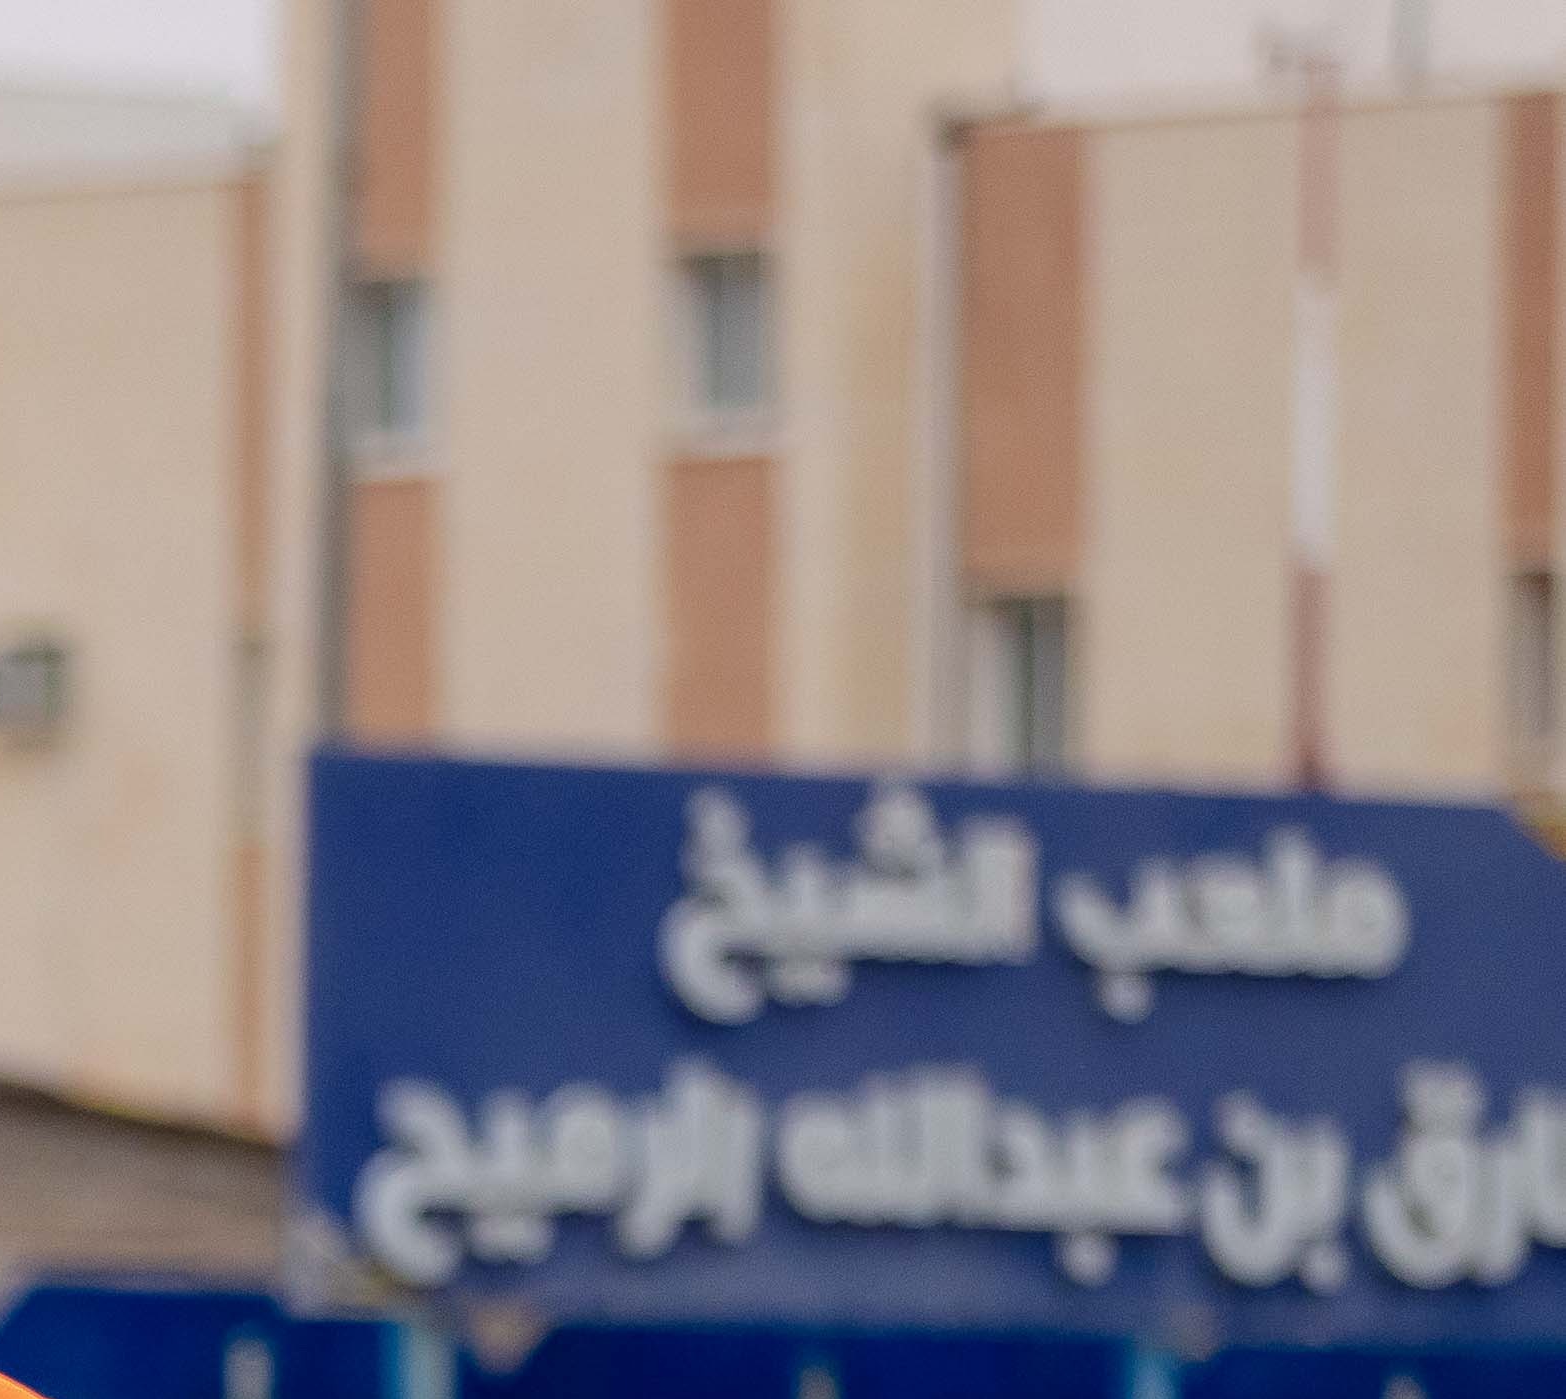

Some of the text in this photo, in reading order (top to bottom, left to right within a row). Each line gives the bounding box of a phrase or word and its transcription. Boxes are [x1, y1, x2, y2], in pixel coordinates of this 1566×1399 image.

[658, 784, 1413, 1025] ملعب الشيخ
[354, 1054, 767, 1288] الرميح
[1365, 1058, 1566, 1290] ارق
